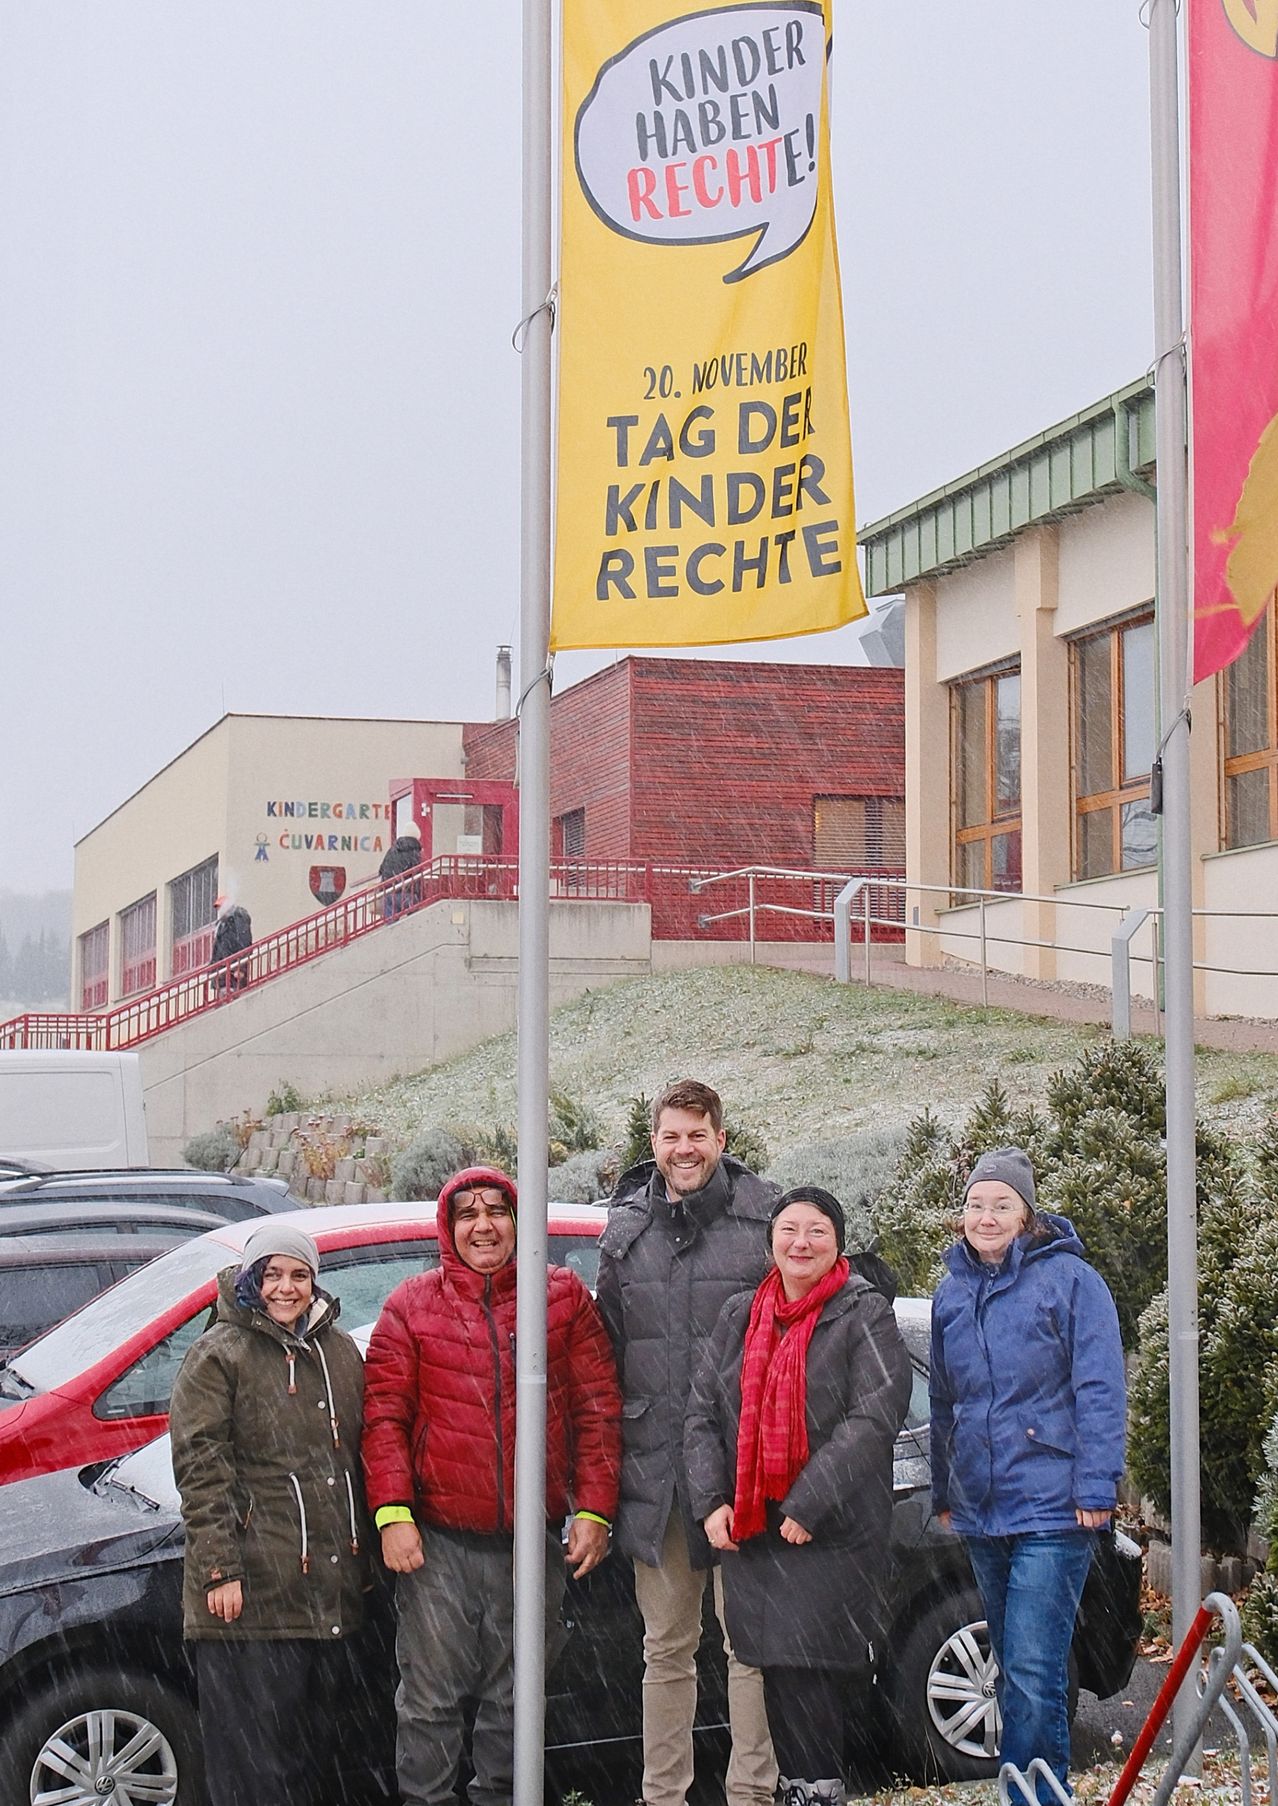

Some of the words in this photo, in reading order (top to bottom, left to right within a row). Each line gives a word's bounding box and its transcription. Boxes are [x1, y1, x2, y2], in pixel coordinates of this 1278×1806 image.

[650, 20, 806, 106] KINDER
[636, 83, 780, 161] HABEN
[627, 113, 816, 222] RECHTE!
[643, 364, 682, 400] 20.
[692, 341, 807, 395] NOVEMBER
[606, 404, 716, 467] TAG
[738, 386, 815, 455] DER
[605, 453, 832, 536] KINDER
[596, 519, 842, 601] RECHTE
